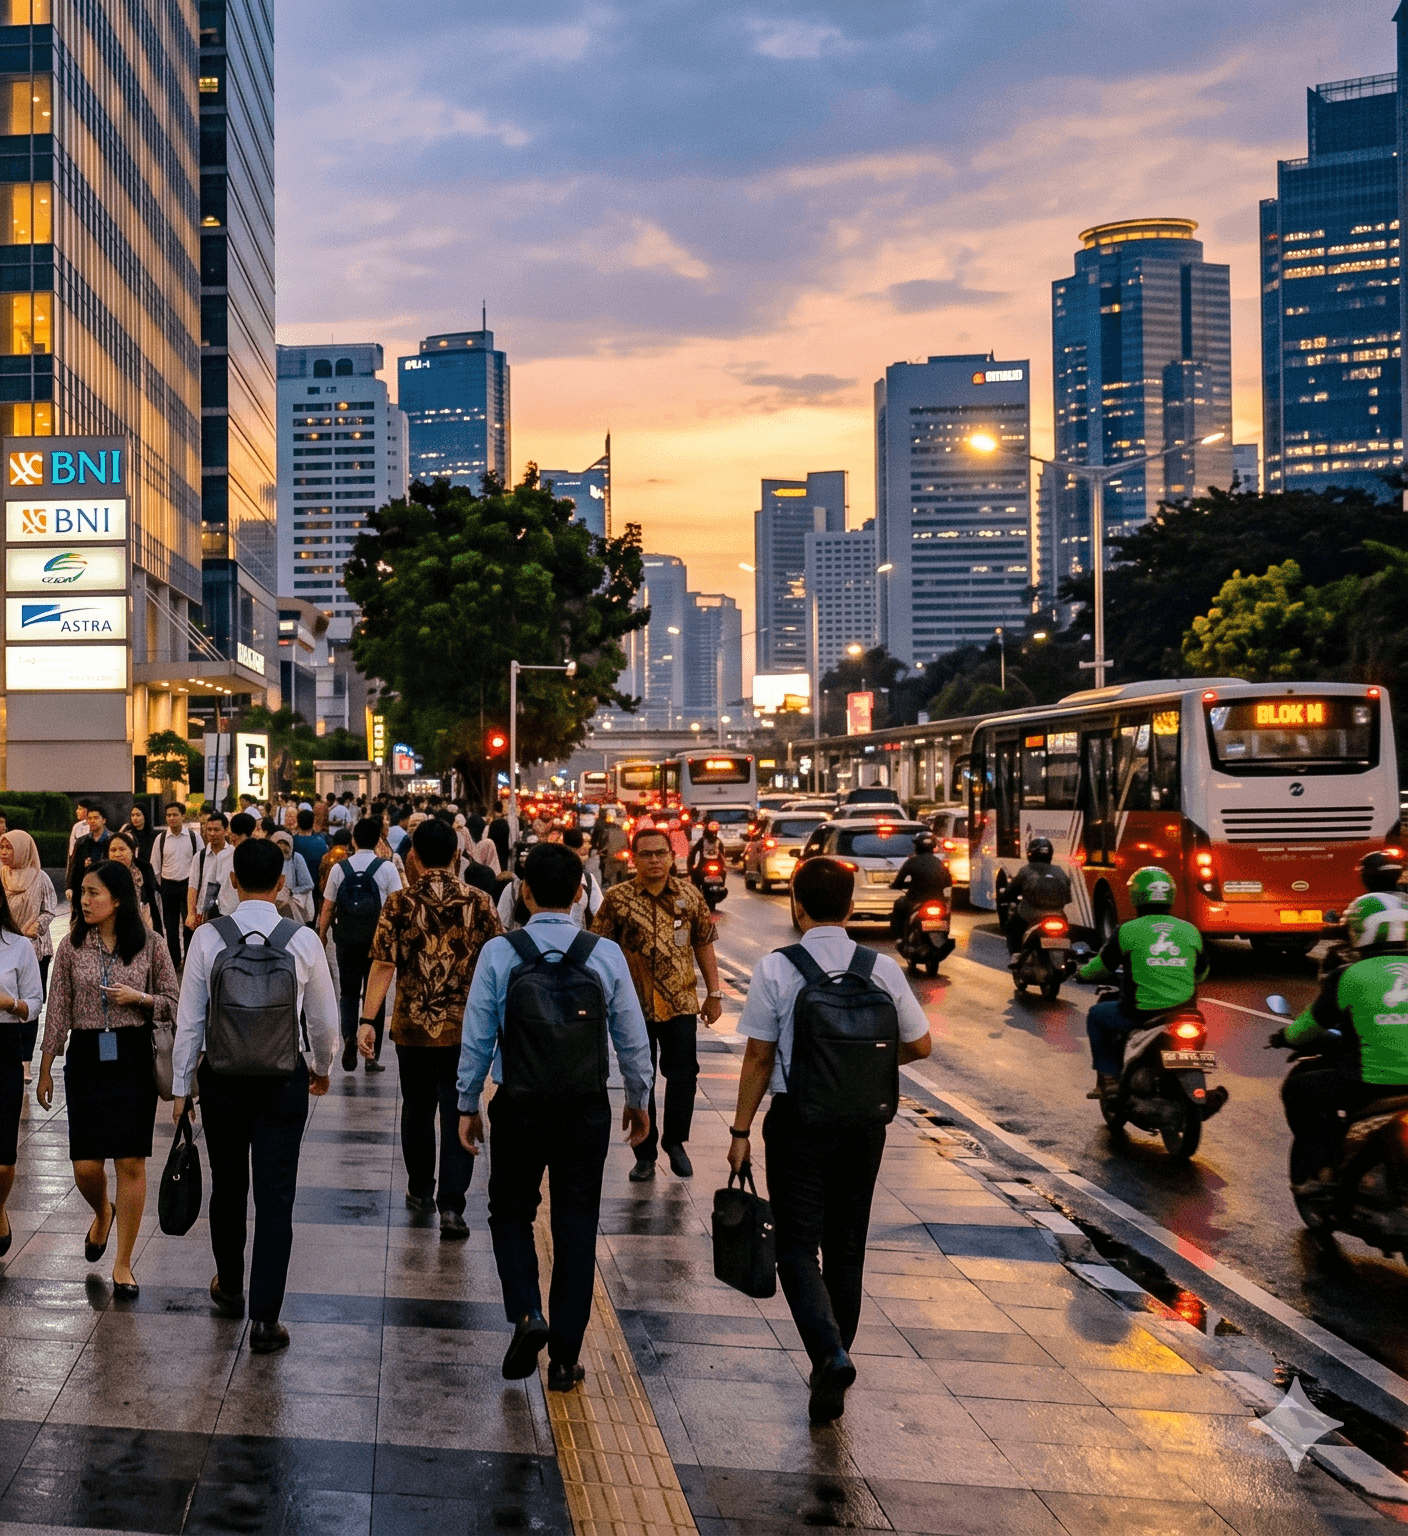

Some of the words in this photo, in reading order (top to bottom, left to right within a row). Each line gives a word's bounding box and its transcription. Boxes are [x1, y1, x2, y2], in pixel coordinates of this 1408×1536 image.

[51, 450, 121, 484] BNI
[55, 508, 109, 533] BNI
[61, 620, 112, 632] ASTRA
[1257, 704, 1304, 723] BLOK
